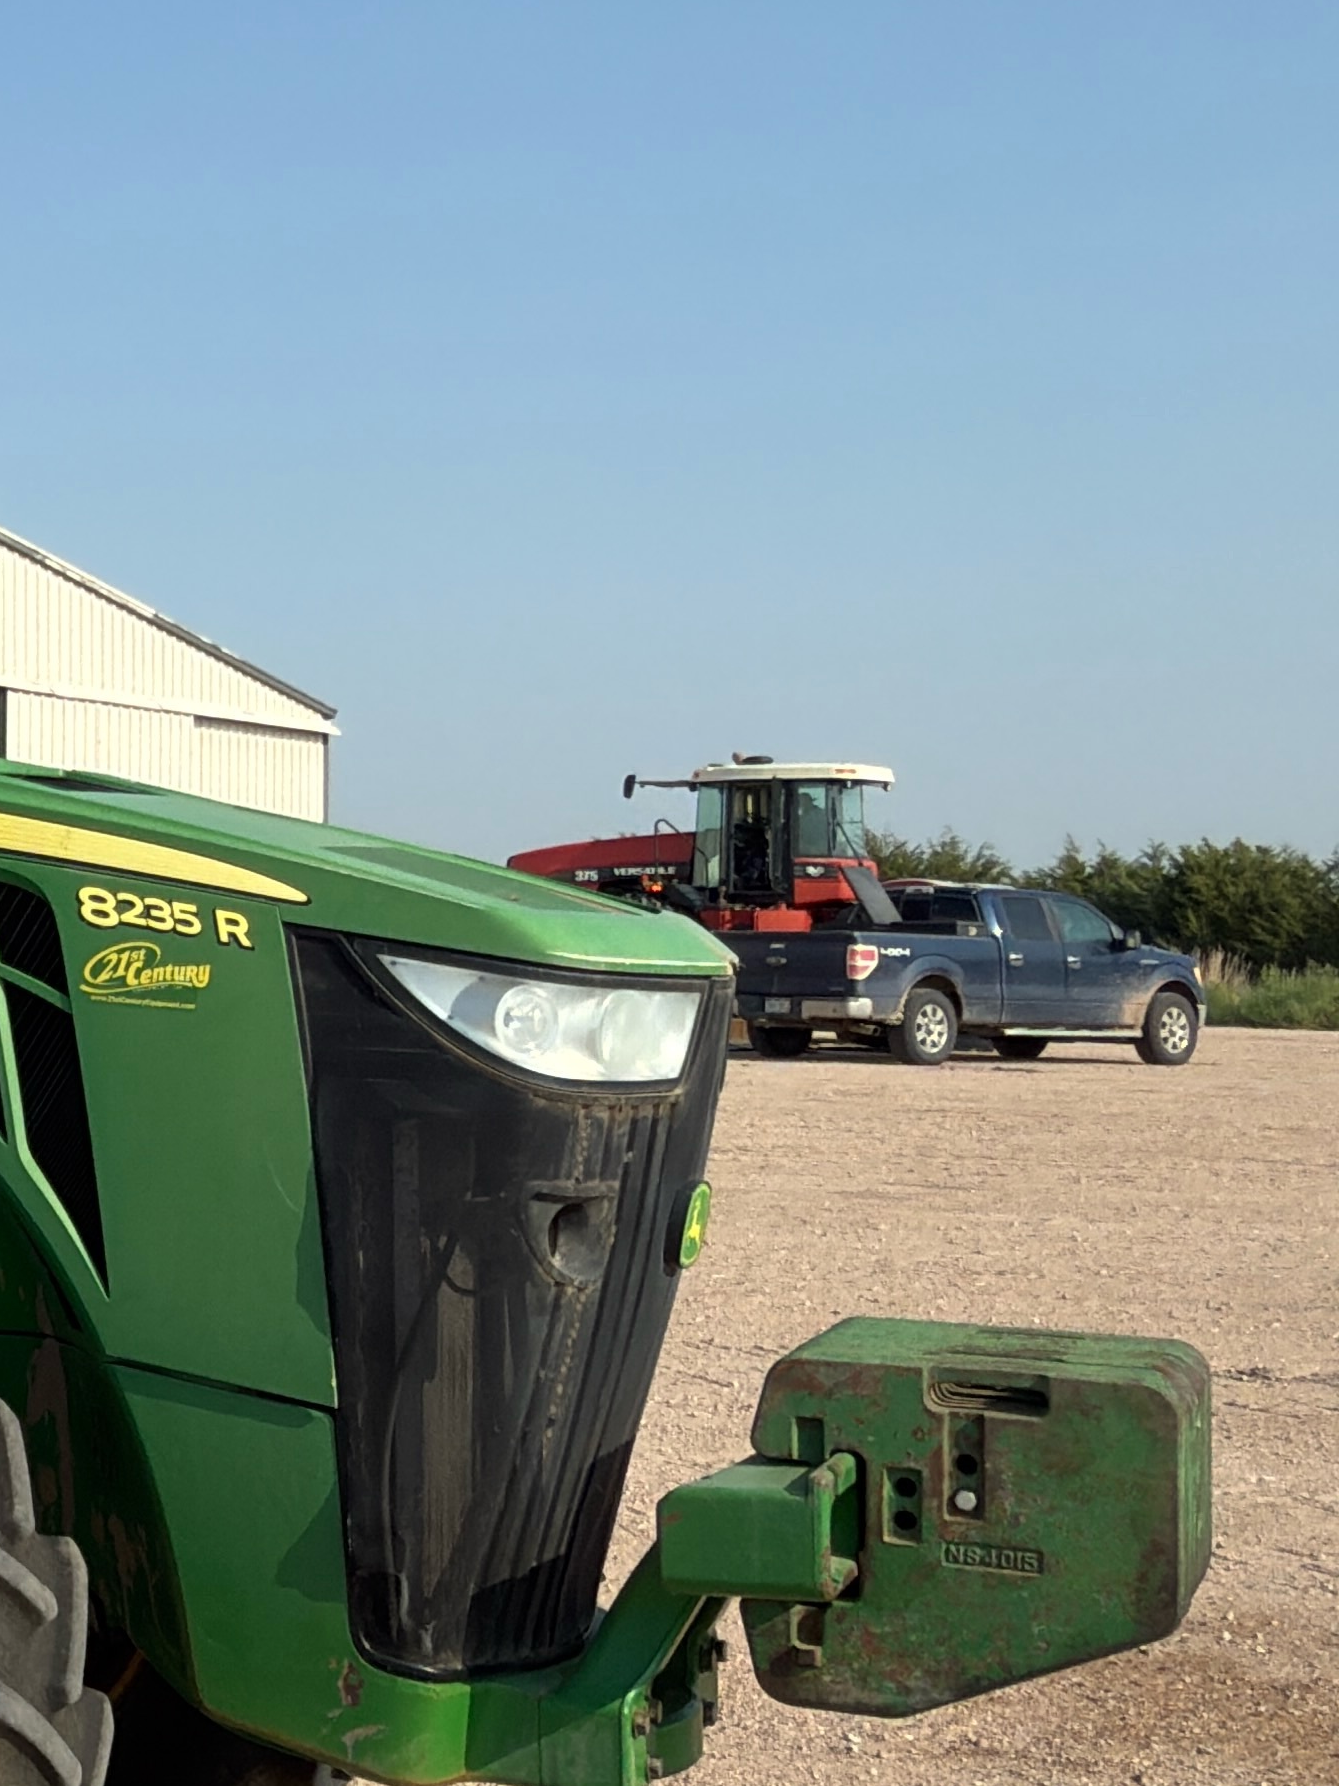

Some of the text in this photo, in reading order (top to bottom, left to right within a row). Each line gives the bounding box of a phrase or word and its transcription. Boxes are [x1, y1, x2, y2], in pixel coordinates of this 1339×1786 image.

[575, 870, 599, 882] 375
[77, 886, 254, 950] 8235 R
[95, 947, 147, 984] 21st
